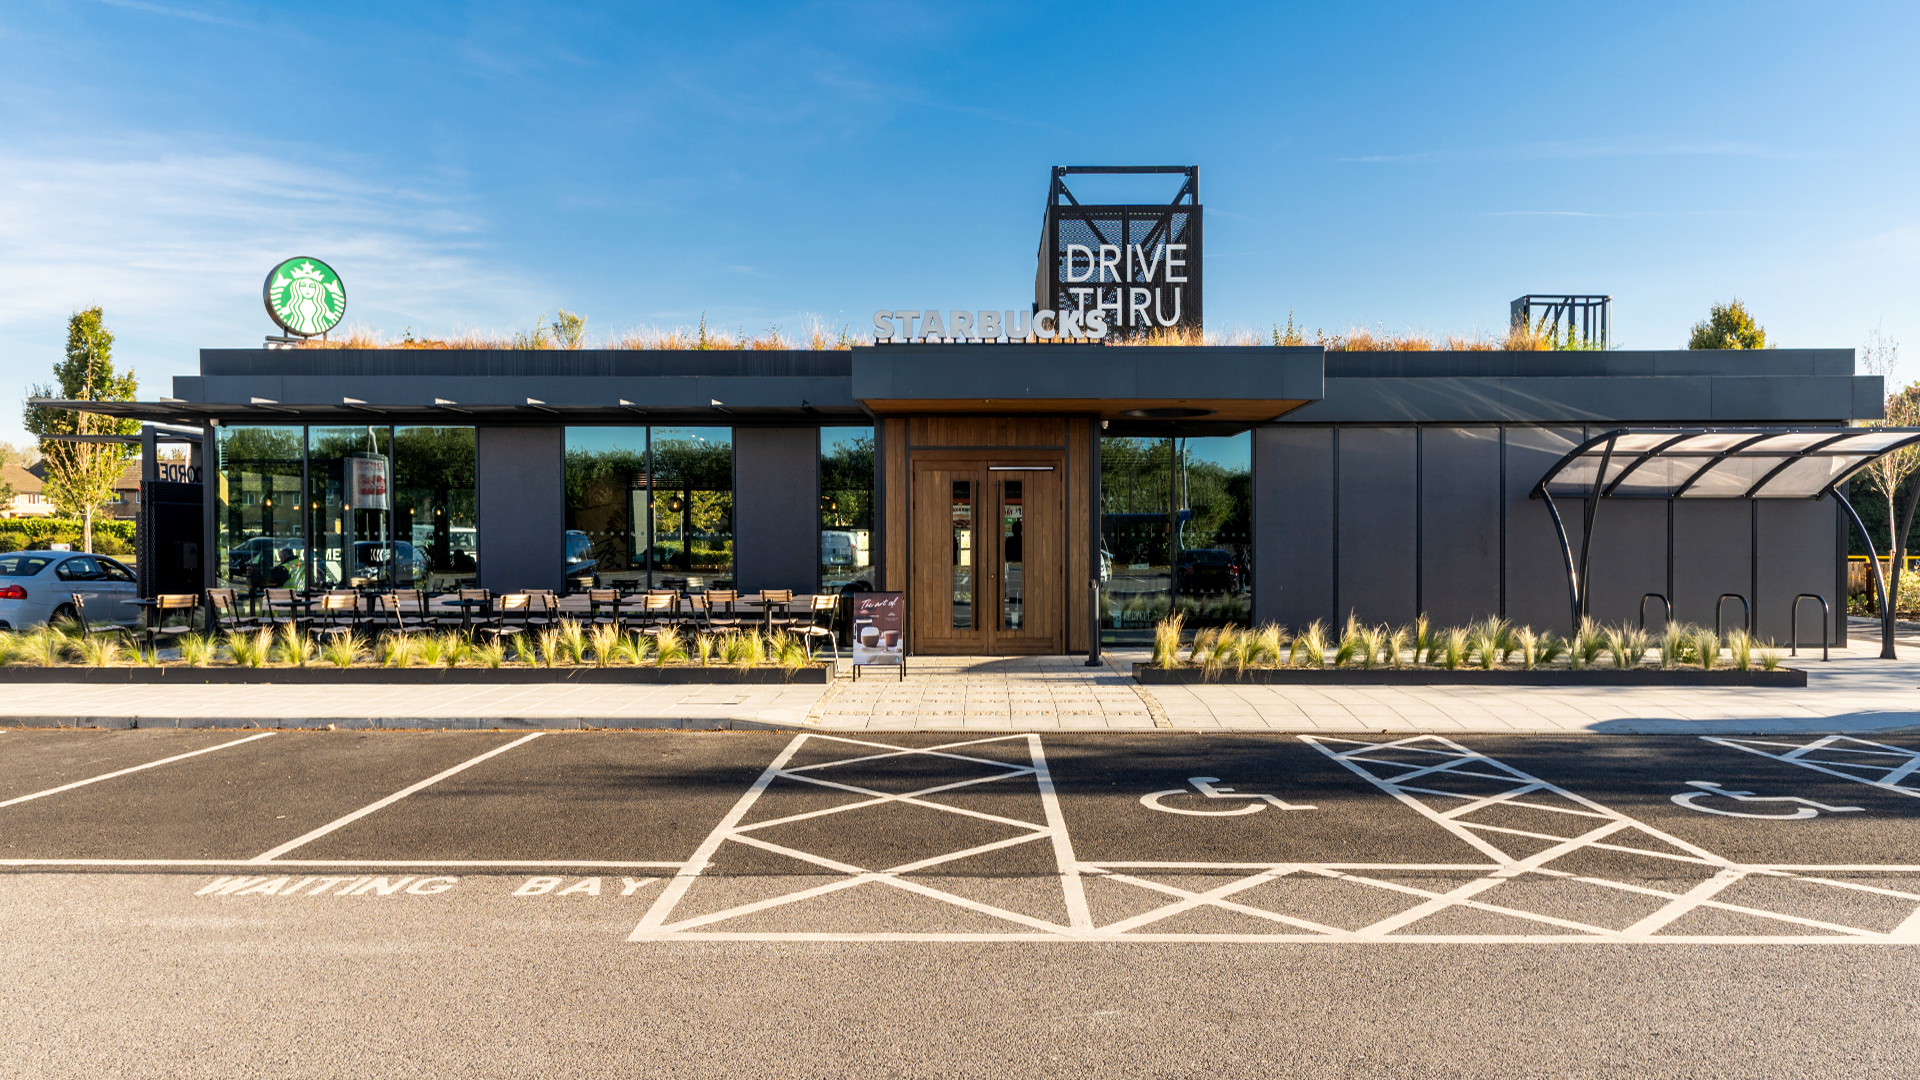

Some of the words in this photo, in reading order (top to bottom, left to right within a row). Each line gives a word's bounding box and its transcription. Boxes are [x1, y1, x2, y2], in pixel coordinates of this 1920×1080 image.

[1067, 244, 1187, 283] DRIVE
[1069, 287, 1181, 327] THRU
[873, 310, 1108, 338] STARBUCKS
[861, 598, 874, 610] The
[874, 598, 888, 607] art
[888, 596, 899, 609] of
[1123, 610, 1152, 622] RECYCLE
[194, 877, 459, 896] WAITING
[512, 876, 660, 896] BAY
